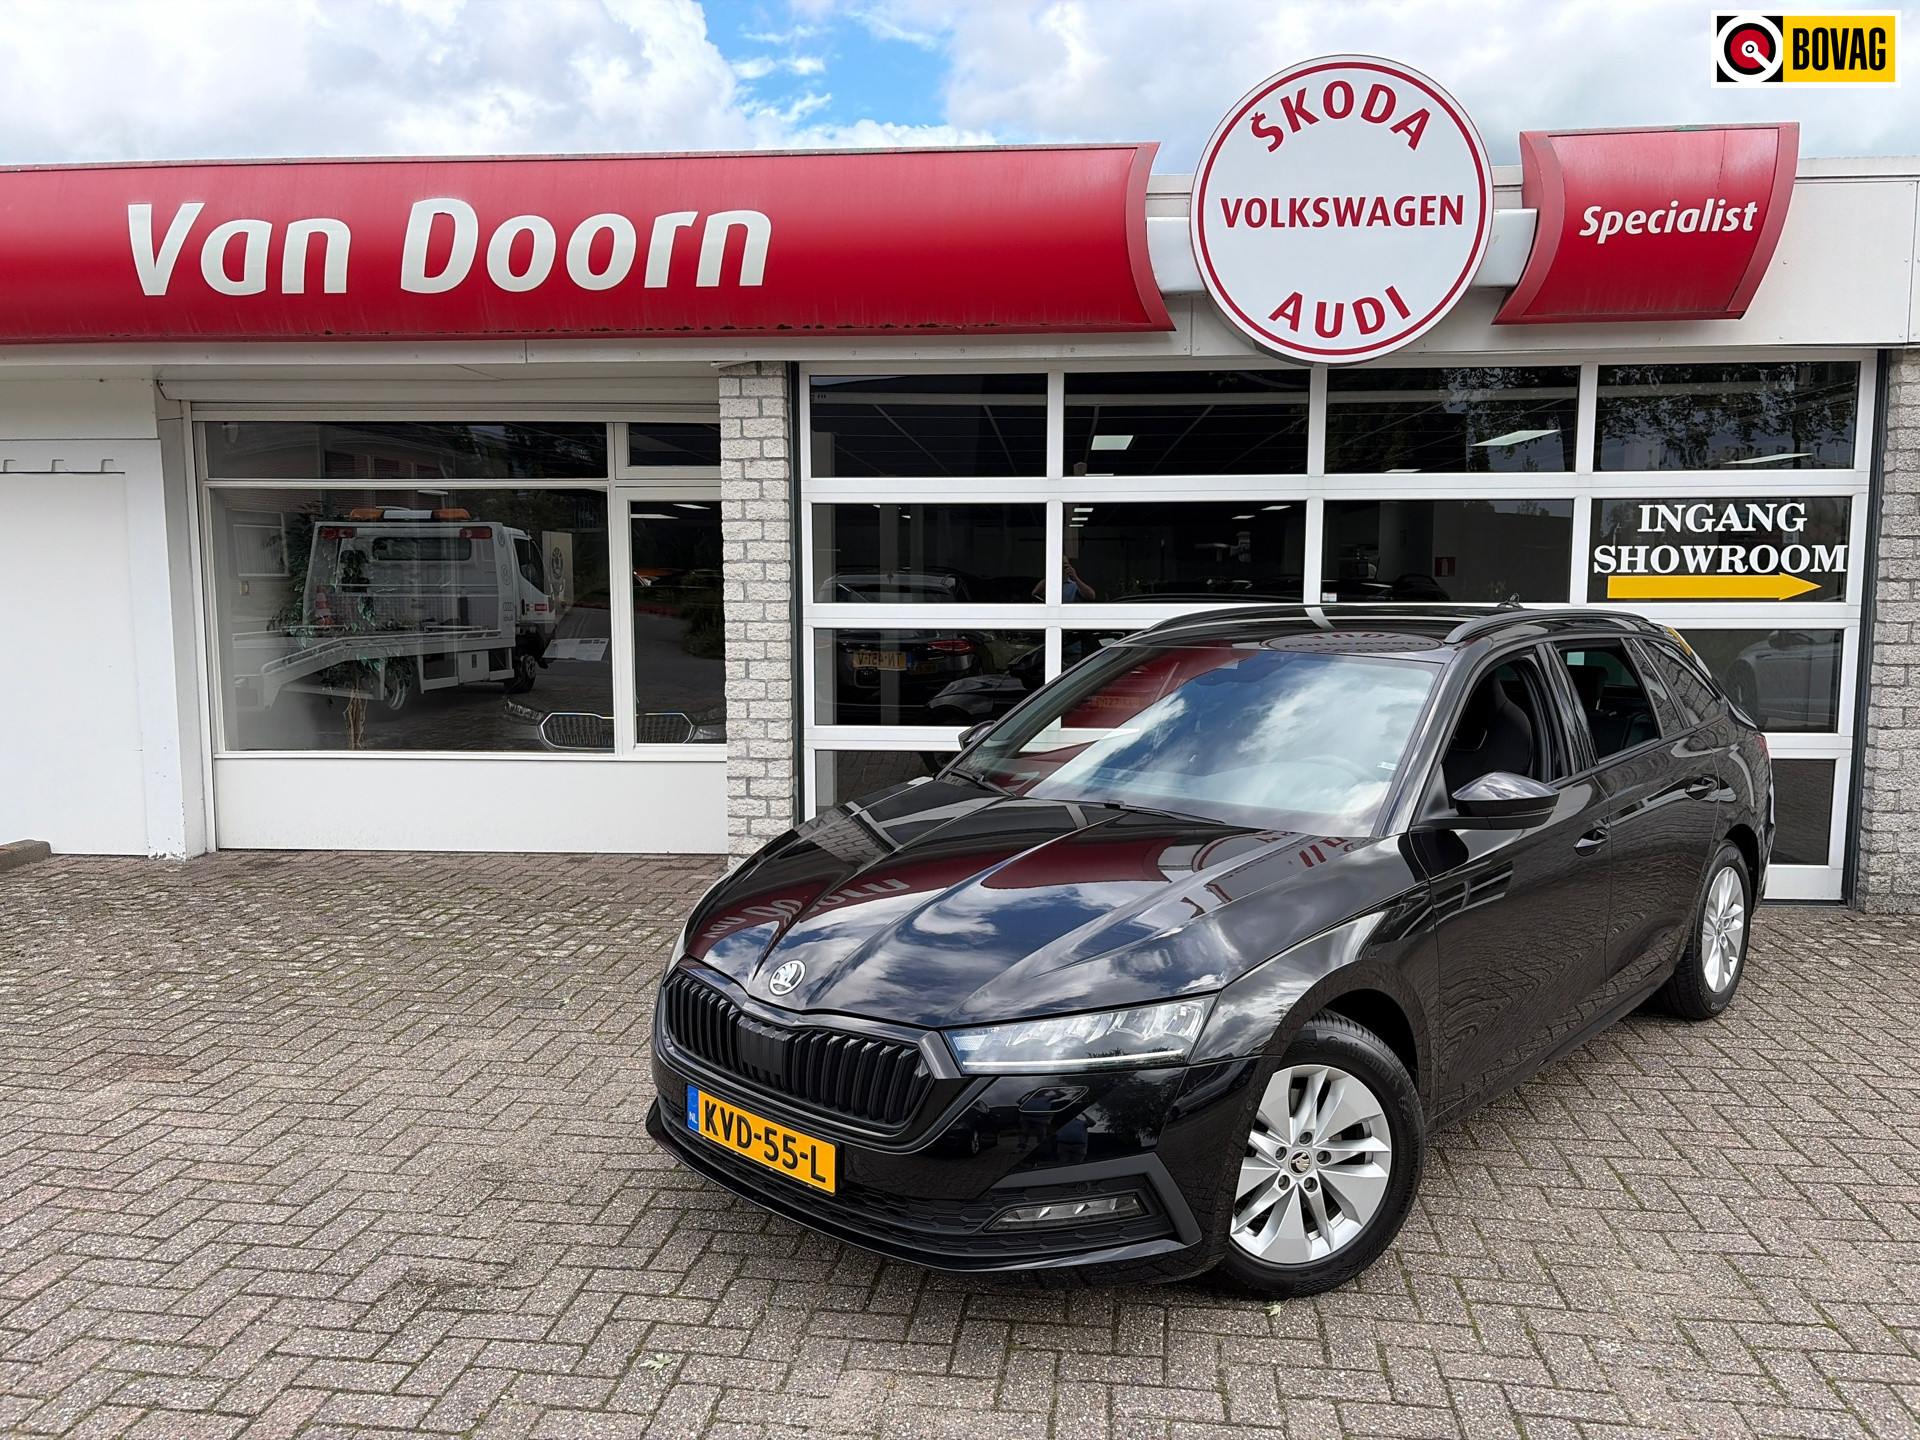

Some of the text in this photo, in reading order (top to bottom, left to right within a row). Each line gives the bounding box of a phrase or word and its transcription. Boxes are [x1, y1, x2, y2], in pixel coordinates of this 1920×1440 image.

[1249, 80, 1432, 153] ŠKODA
[1221, 195, 1464, 229] VOLKSWAGEN
[1579, 198, 1758, 244] Specialist
[127, 198, 772, 296] Van Doorn
[1268, 285, 1413, 340] AUDI
[1637, 502, 1808, 533] INGANG
[1593, 544, 1849, 574] SHOWROOM
[688, 1111, 698, 1124] NL
[703, 1099, 827, 1184] KVD-55-L
